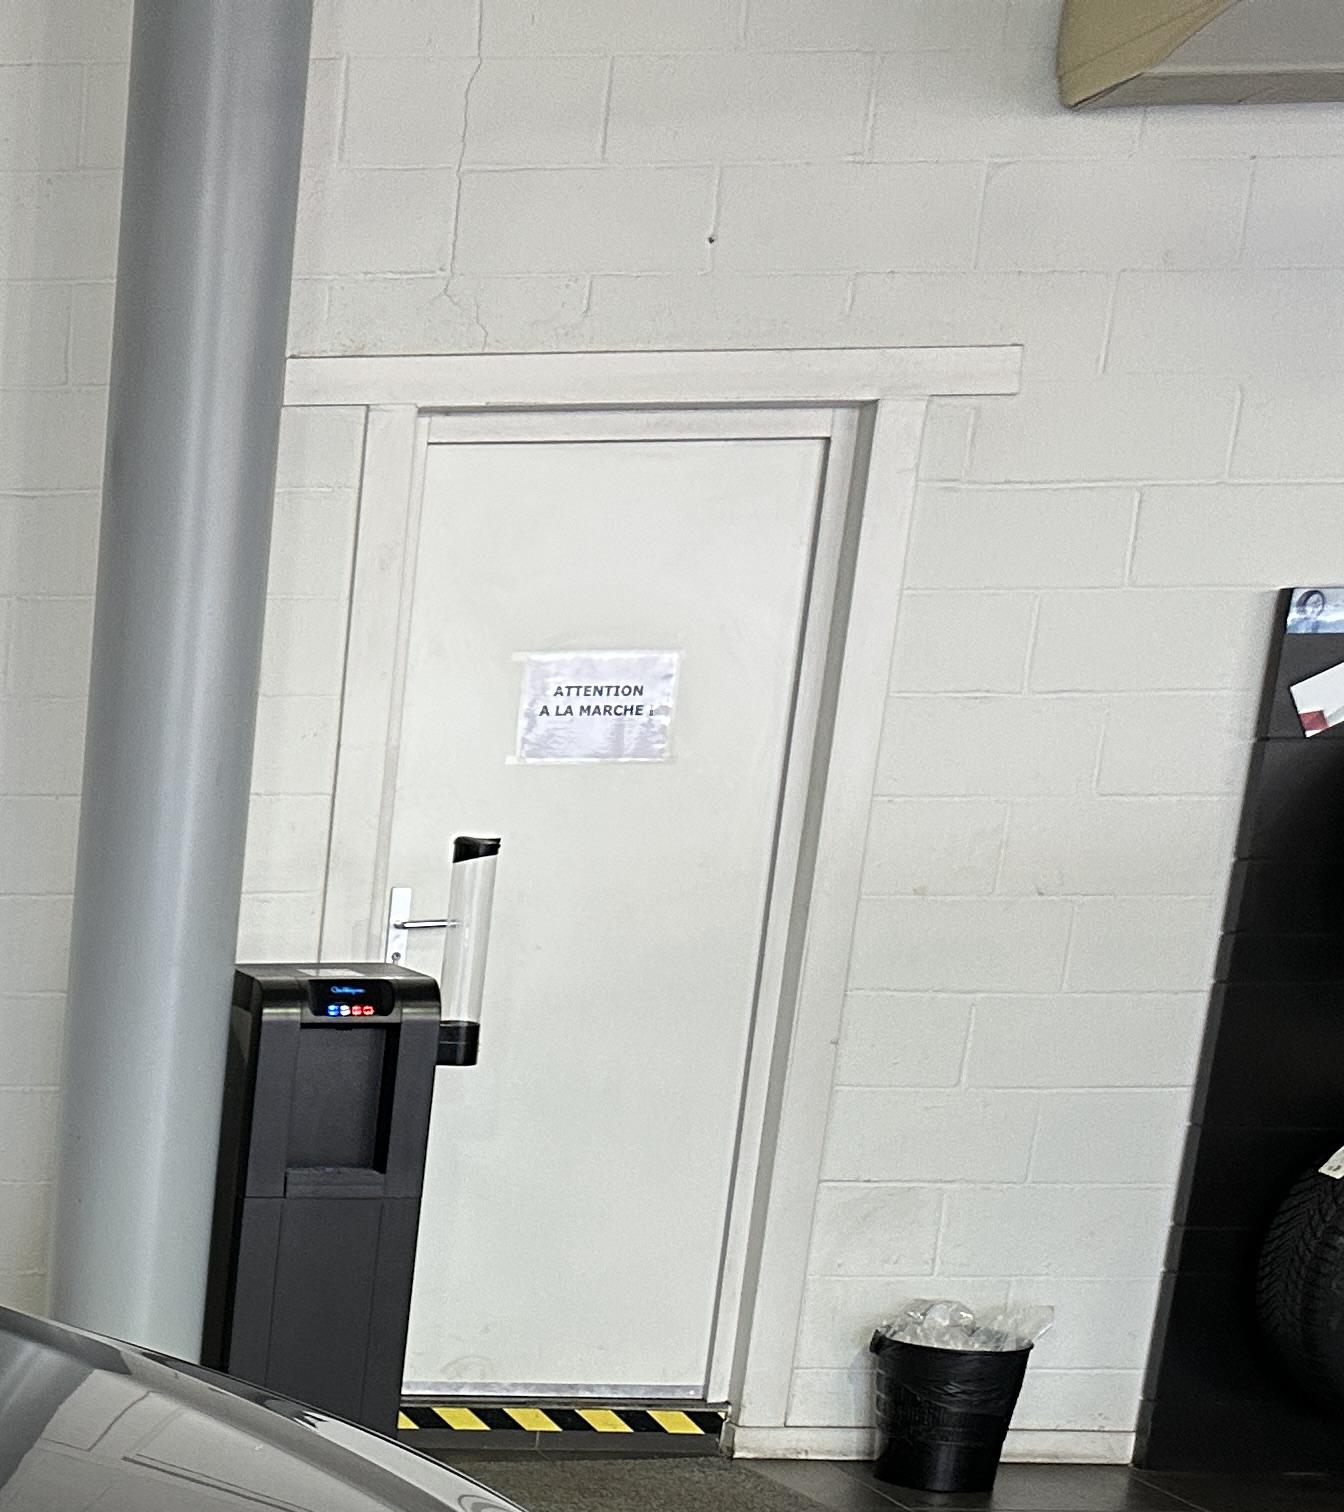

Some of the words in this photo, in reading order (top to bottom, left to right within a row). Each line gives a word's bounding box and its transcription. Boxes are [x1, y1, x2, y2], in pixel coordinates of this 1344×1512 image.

[553, 685, 644, 697] ATTENTION
[538, 705, 550, 717] A
[555, 705, 574, 717] LA
[578, 704, 644, 717] MARCHE
